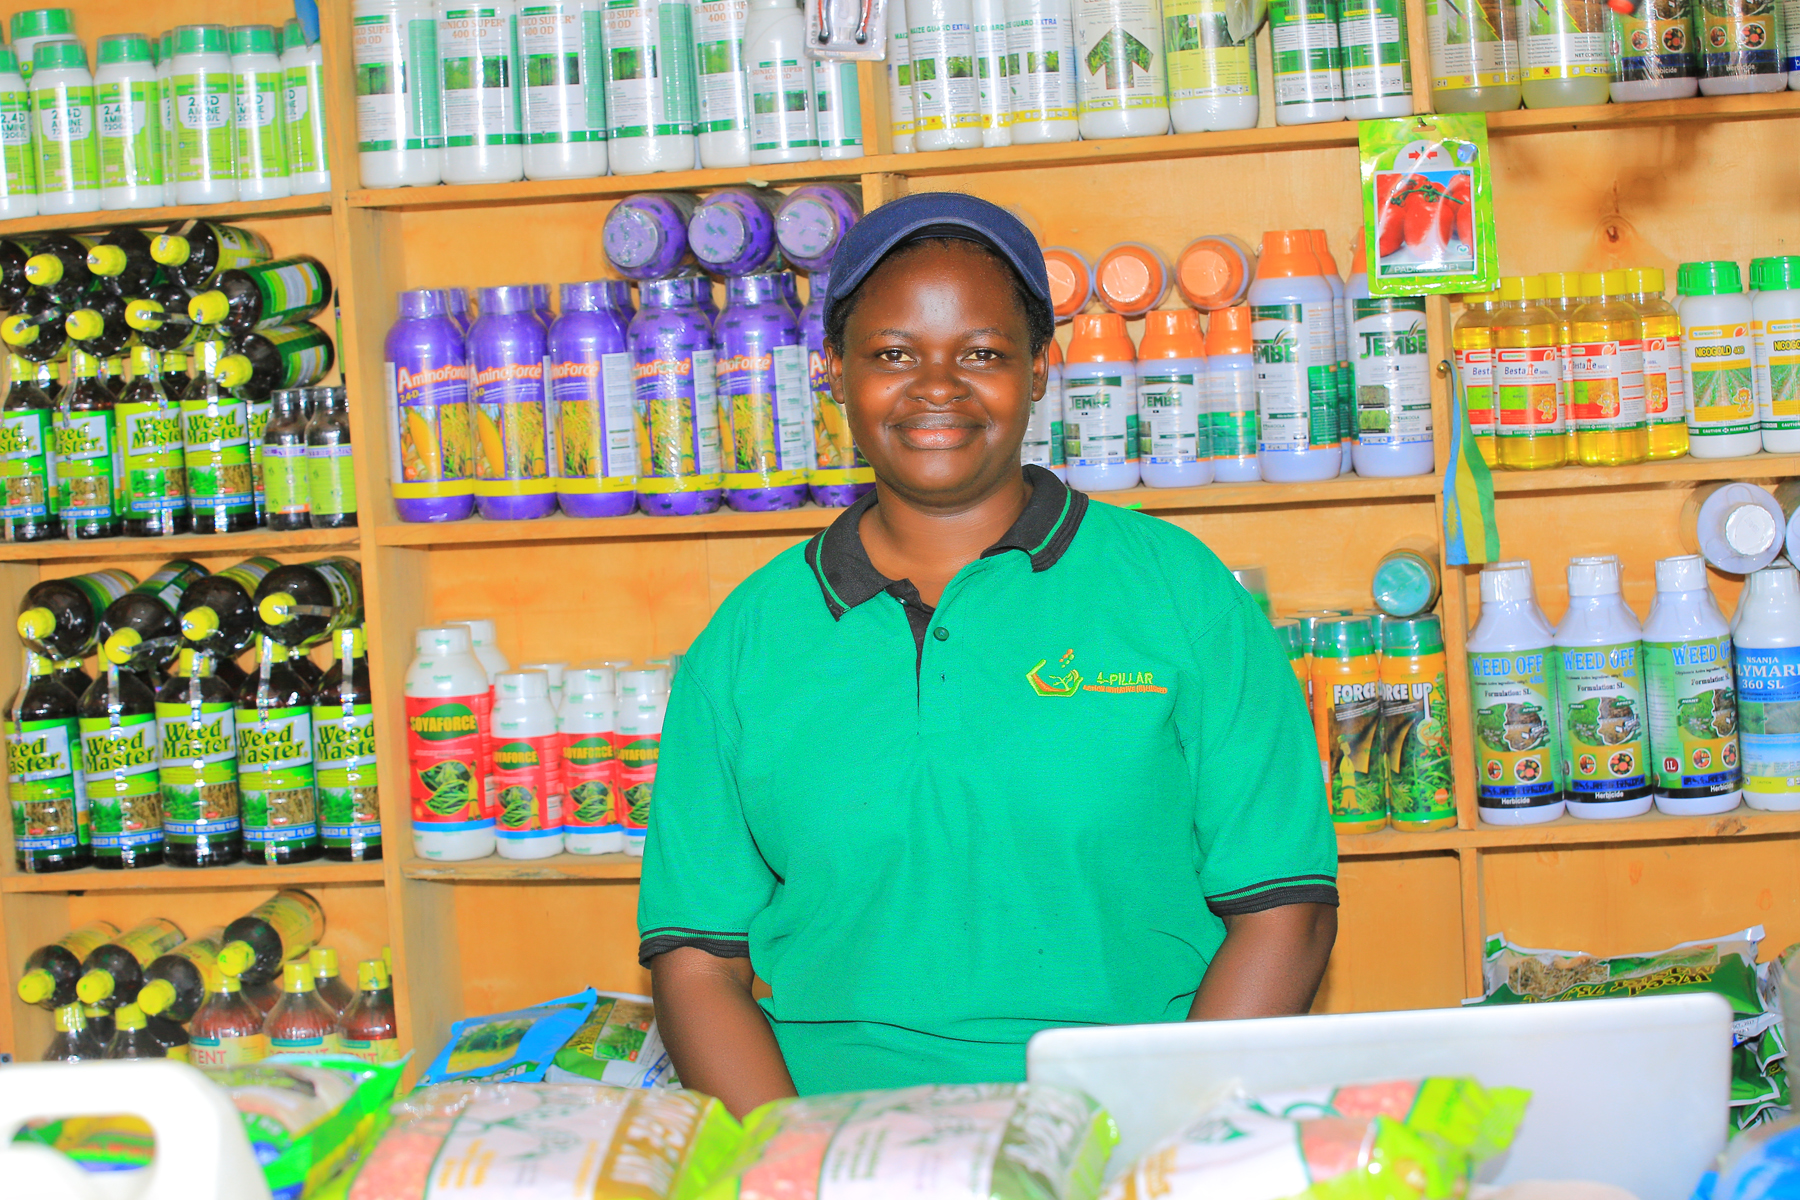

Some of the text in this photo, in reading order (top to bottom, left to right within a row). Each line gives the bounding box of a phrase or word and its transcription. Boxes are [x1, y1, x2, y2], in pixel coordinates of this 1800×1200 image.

[1695, 345, 1733, 359] NICOGOLD
[1563, 649, 1605, 671] WEED
[1673, 644, 1717, 667] WEED
[1747, 656, 1779, 665] NSANJA
[1472, 653, 1544, 677] WEED OFF
[1577, 683, 1615, 693] Formulation:
[1742, 679, 1784, 690] 360 SL
[1484, 690, 1521, 698] Formulation:
[164, 716, 224, 742] Weed
[238, 720, 294, 748] Weed
[86, 728, 147, 756] Weed
[1501, 797, 1530, 806] Herbicide
[1595, 791, 1623, 800] Herbicide
[1627, 970, 1712, 997] Weed
